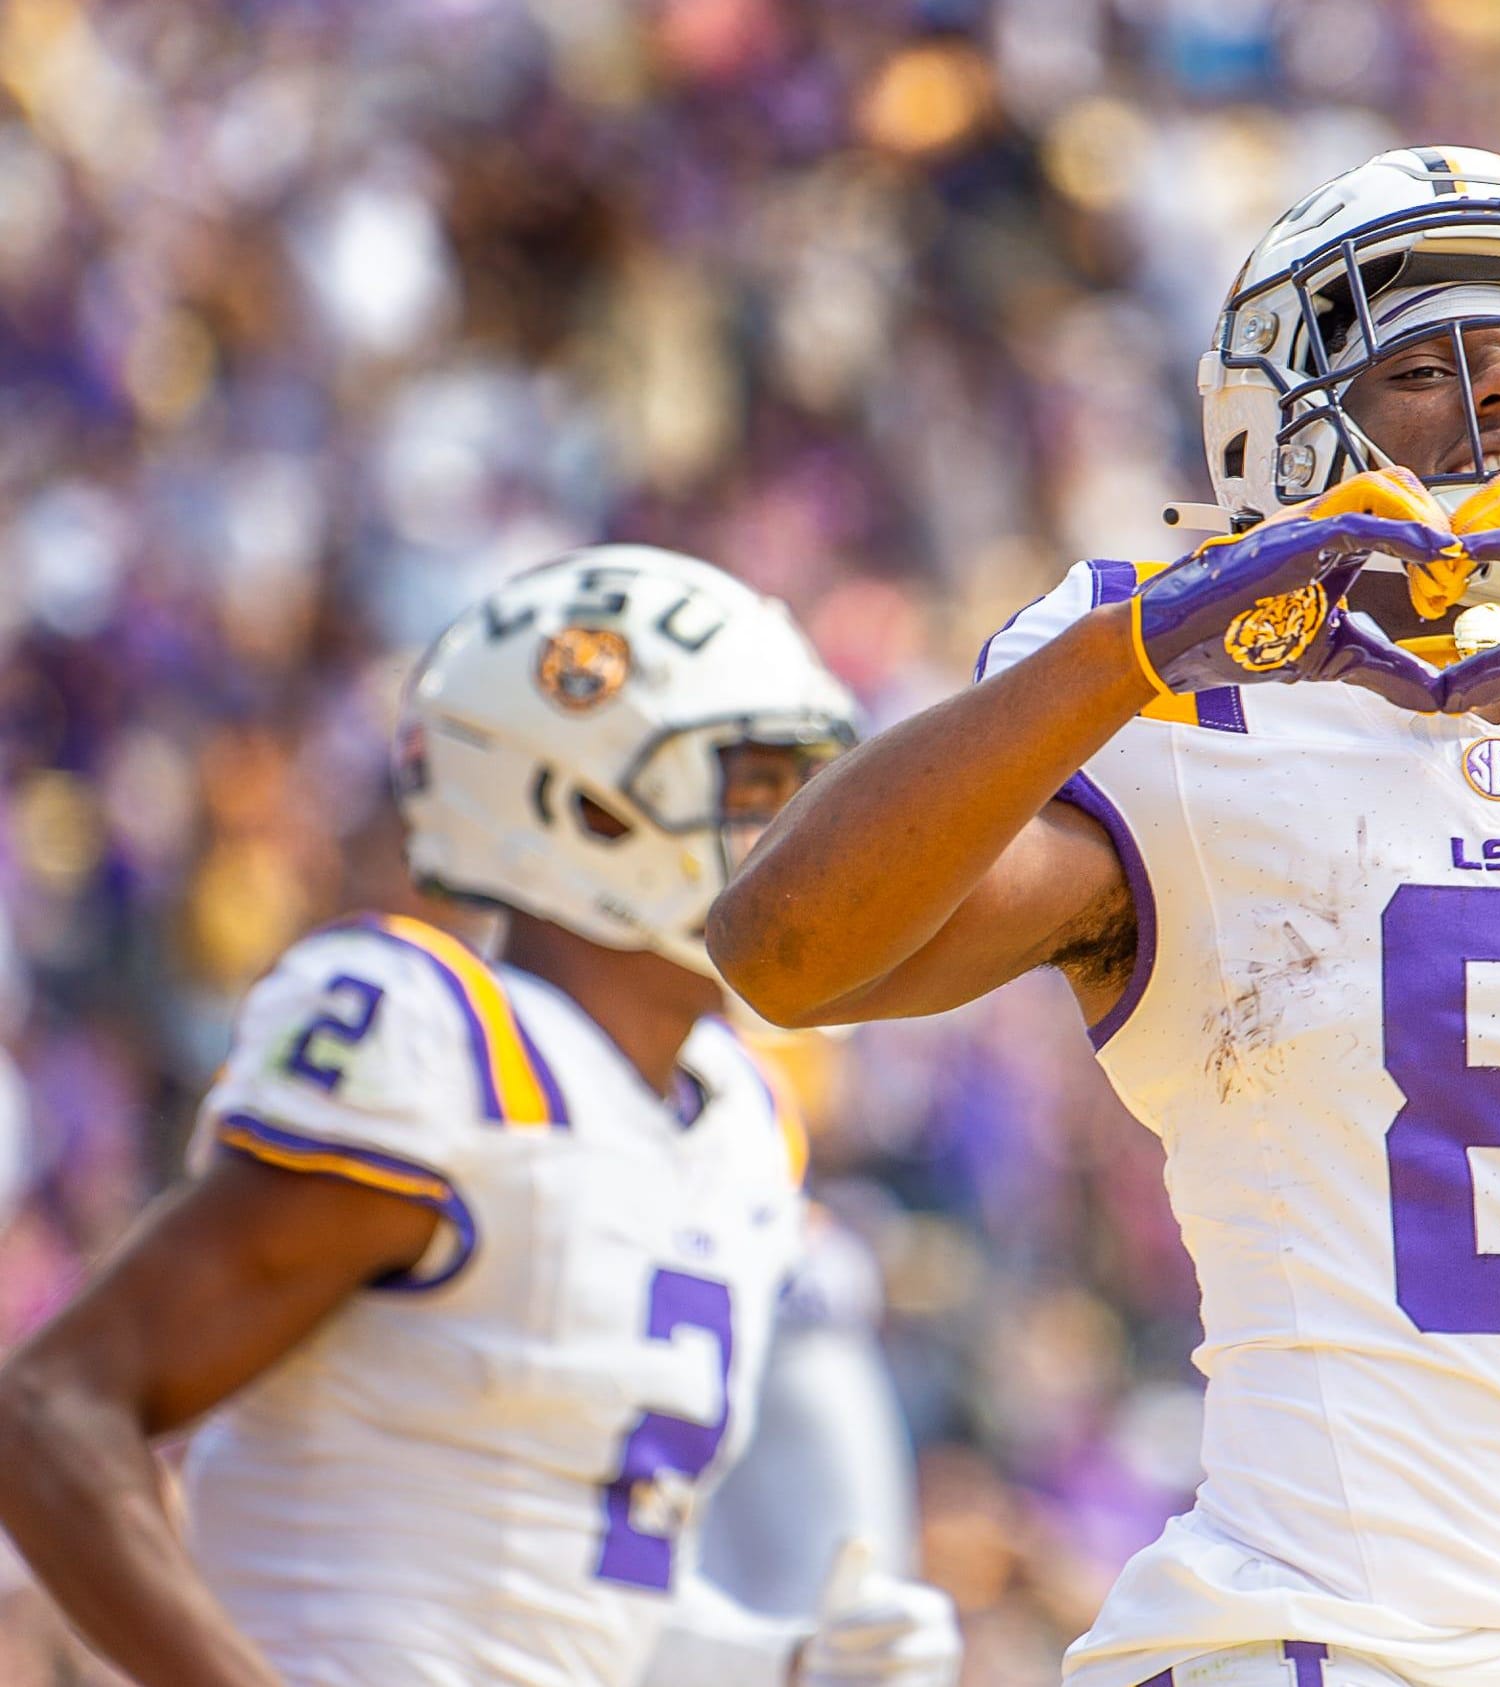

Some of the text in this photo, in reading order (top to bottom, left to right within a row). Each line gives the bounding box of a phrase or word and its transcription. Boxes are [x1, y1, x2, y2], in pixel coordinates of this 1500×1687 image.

[483, 568, 728, 656] LSU
[284, 974, 386, 1090] 2
[594, 1266, 733, 1590] 2
